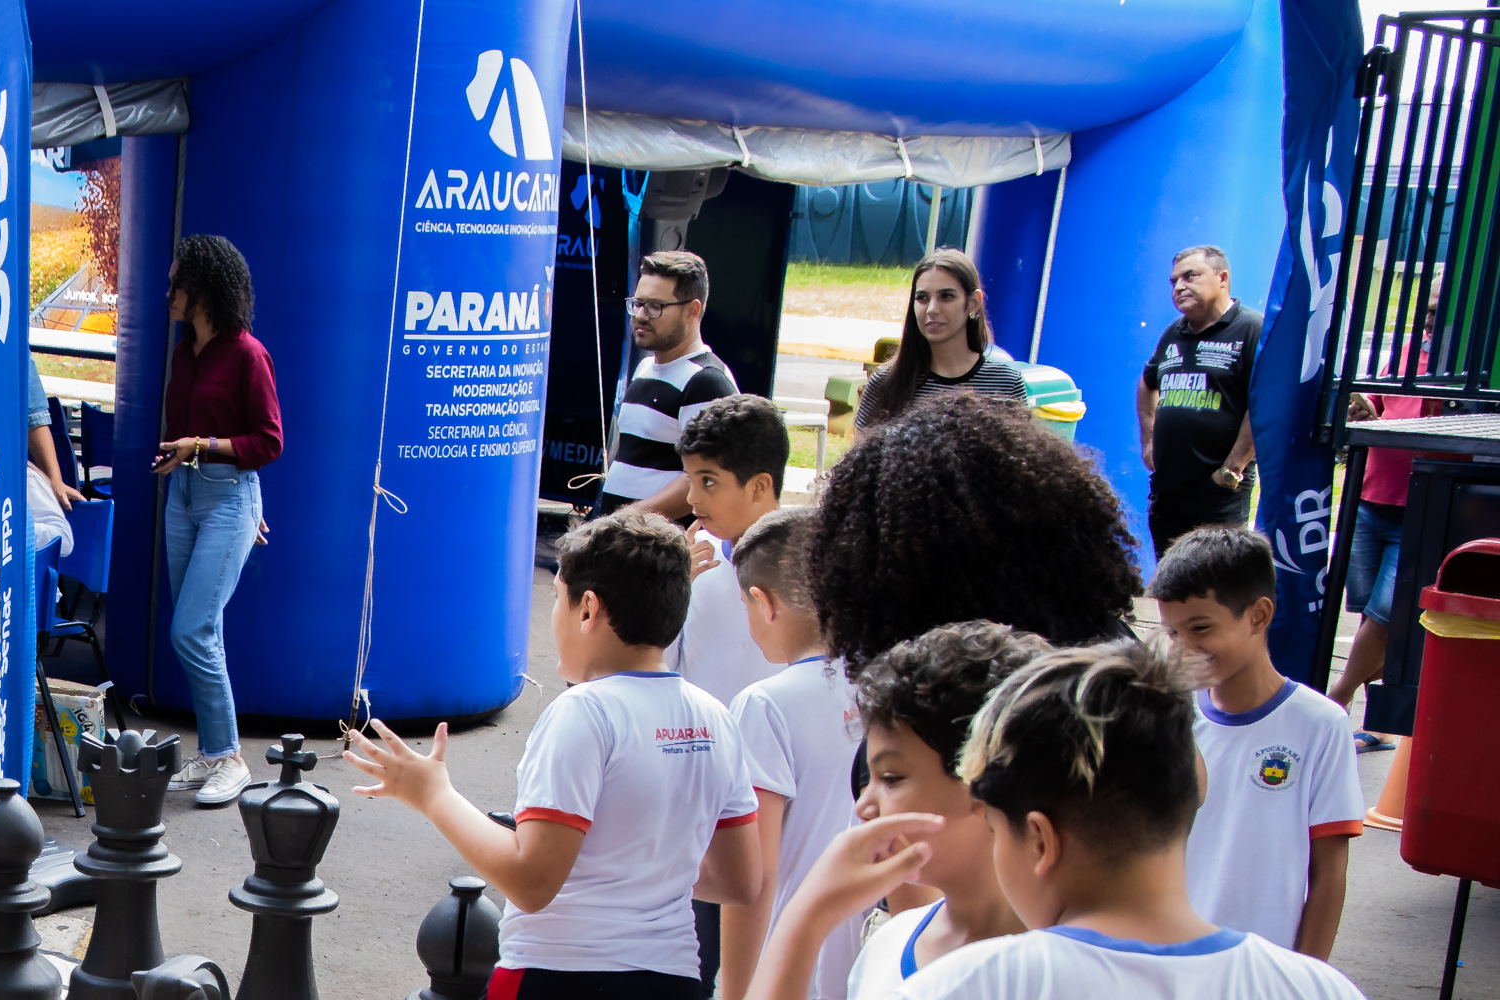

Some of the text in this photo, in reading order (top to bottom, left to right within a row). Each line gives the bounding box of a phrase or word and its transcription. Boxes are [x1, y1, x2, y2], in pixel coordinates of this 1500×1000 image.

[415, 220, 455, 235] CIÊNCIA,
[456, 223, 504, 235] TECNOLOGIA
[509, 222, 538, 237] INOVAÇÃO
[63, 288, 99, 304] Juntos,
[404, 284, 540, 331] PARANÁ
[402, 344, 491, 356] GOVERNO
[501, 344, 518, 355] DO
[426, 365, 497, 379] SECRETARIA
[498, 364, 511, 378] DA
[453, 379, 533, 397] MODERNIZAÇÃO E
[426, 399, 540, 417] TRANSFORMAÇÃO DIGITAL
[428, 421, 528, 440] SECRETARIA DA CIÊNCIA,
[398, 439, 537, 458] TECNOLOGIA E ENSINO SUPERIOR
[1294, 484, 1331, 554] PR
[2, 497, 13, 566] IFPD
[1255, 746, 1301, 763] APUCARANA
